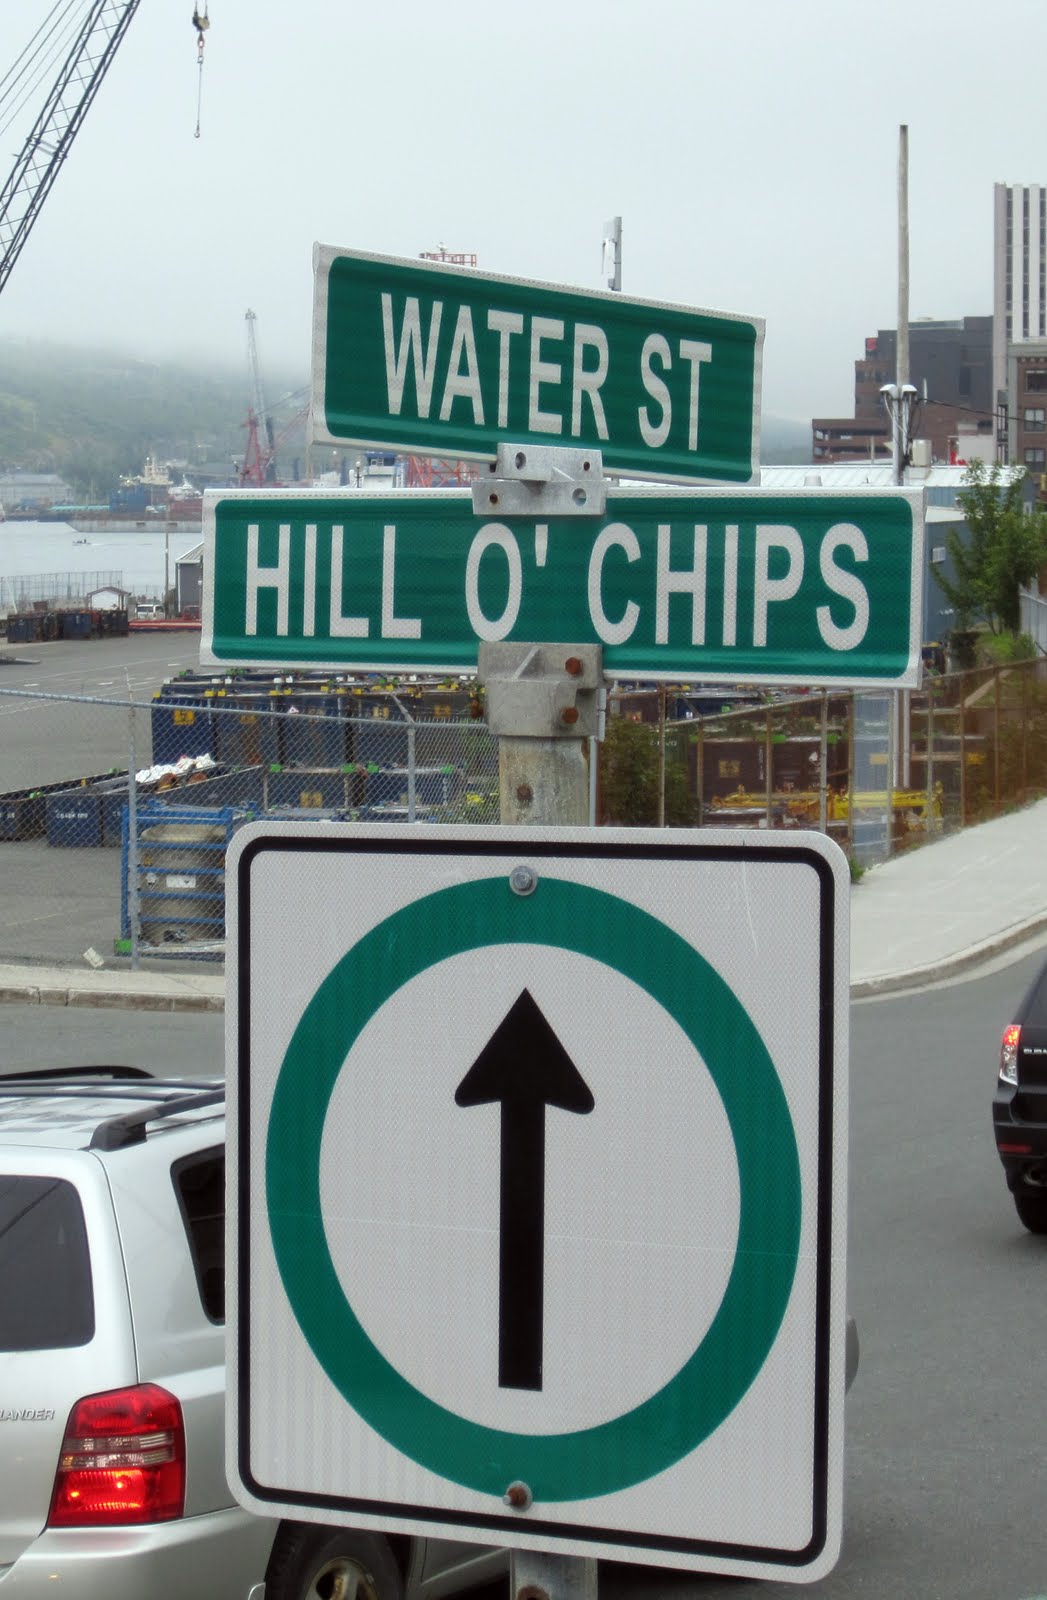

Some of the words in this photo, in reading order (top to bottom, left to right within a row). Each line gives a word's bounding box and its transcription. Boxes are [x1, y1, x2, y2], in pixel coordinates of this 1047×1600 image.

[381, 293, 609, 440] WATER
[638, 333, 712, 451] ST
[245, 524, 422, 639] HILL
[465, 522, 549, 642] O'
[587, 522, 870, 651] CHIPS
